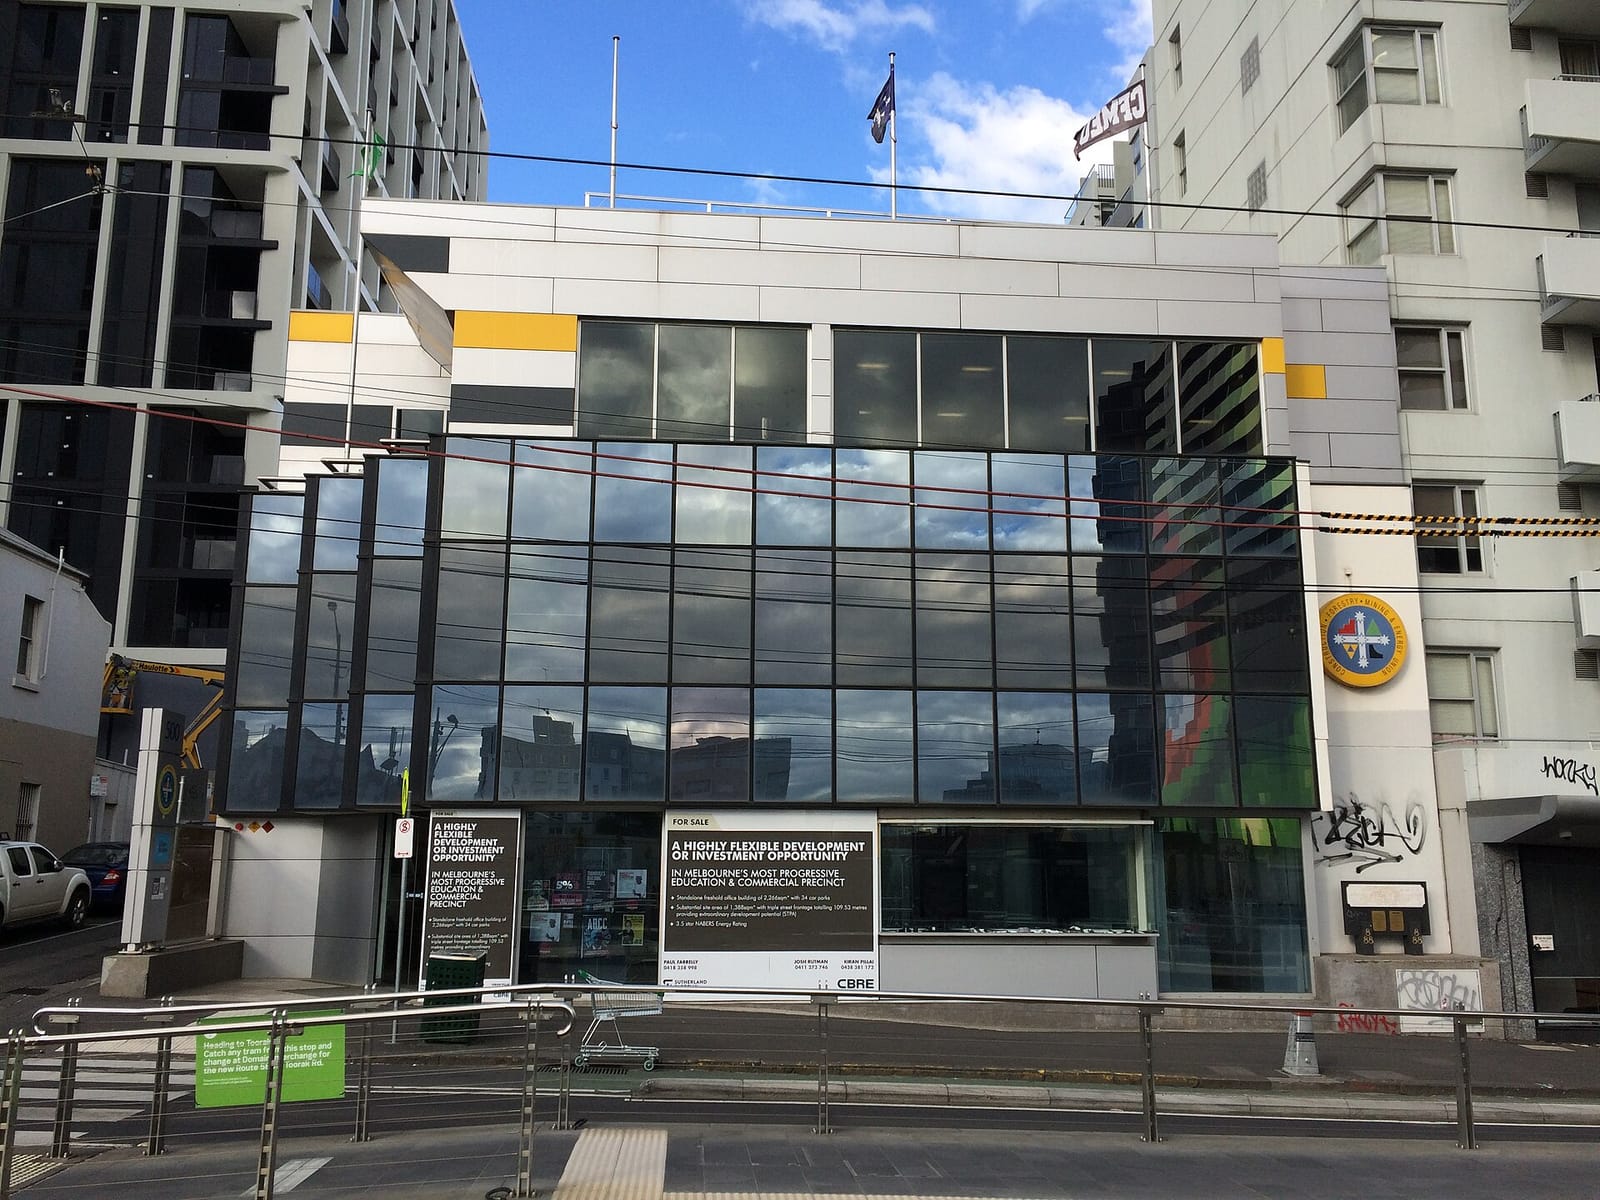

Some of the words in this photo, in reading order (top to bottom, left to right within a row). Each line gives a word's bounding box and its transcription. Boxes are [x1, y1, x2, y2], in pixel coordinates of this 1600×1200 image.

[1328, 597, 1361, 617] FORESTRY
[1364, 598, 1391, 616] MINING
[1394, 626, 1404, 654] ENERGY
[138, 662, 169, 672] Haulotte
[1383, 658, 1399, 676] UNION
[165, 721, 180, 742] 500
[672, 842, 680, 850] A
[684, 841, 727, 851] HIGHLY
[730, 842, 779, 851] FLEXIBLE
[782, 842, 865, 851] DEVELOPMENT
[672, 852, 689, 860] OR
[692, 851, 763, 861] INVESTMENT
[768, 851, 848, 861] OPPORTUNITY
[671, 869, 681, 877] IN
[684, 869, 748, 878] MELBOURNE'S
[751, 869, 777, 878] MOST
[779, 869, 839, 878] PROGRESSIVE
[556, 880, 573, 889] 5%
[671, 878, 726, 887] EDUCATION
[729, 878, 735, 887] &
[738, 878, 799, 887] COMMERCIAL
[802, 878, 845, 887] PRECINCT
[838, 979, 874, 989] CBRE
[204, 1058, 231, 1066] change
